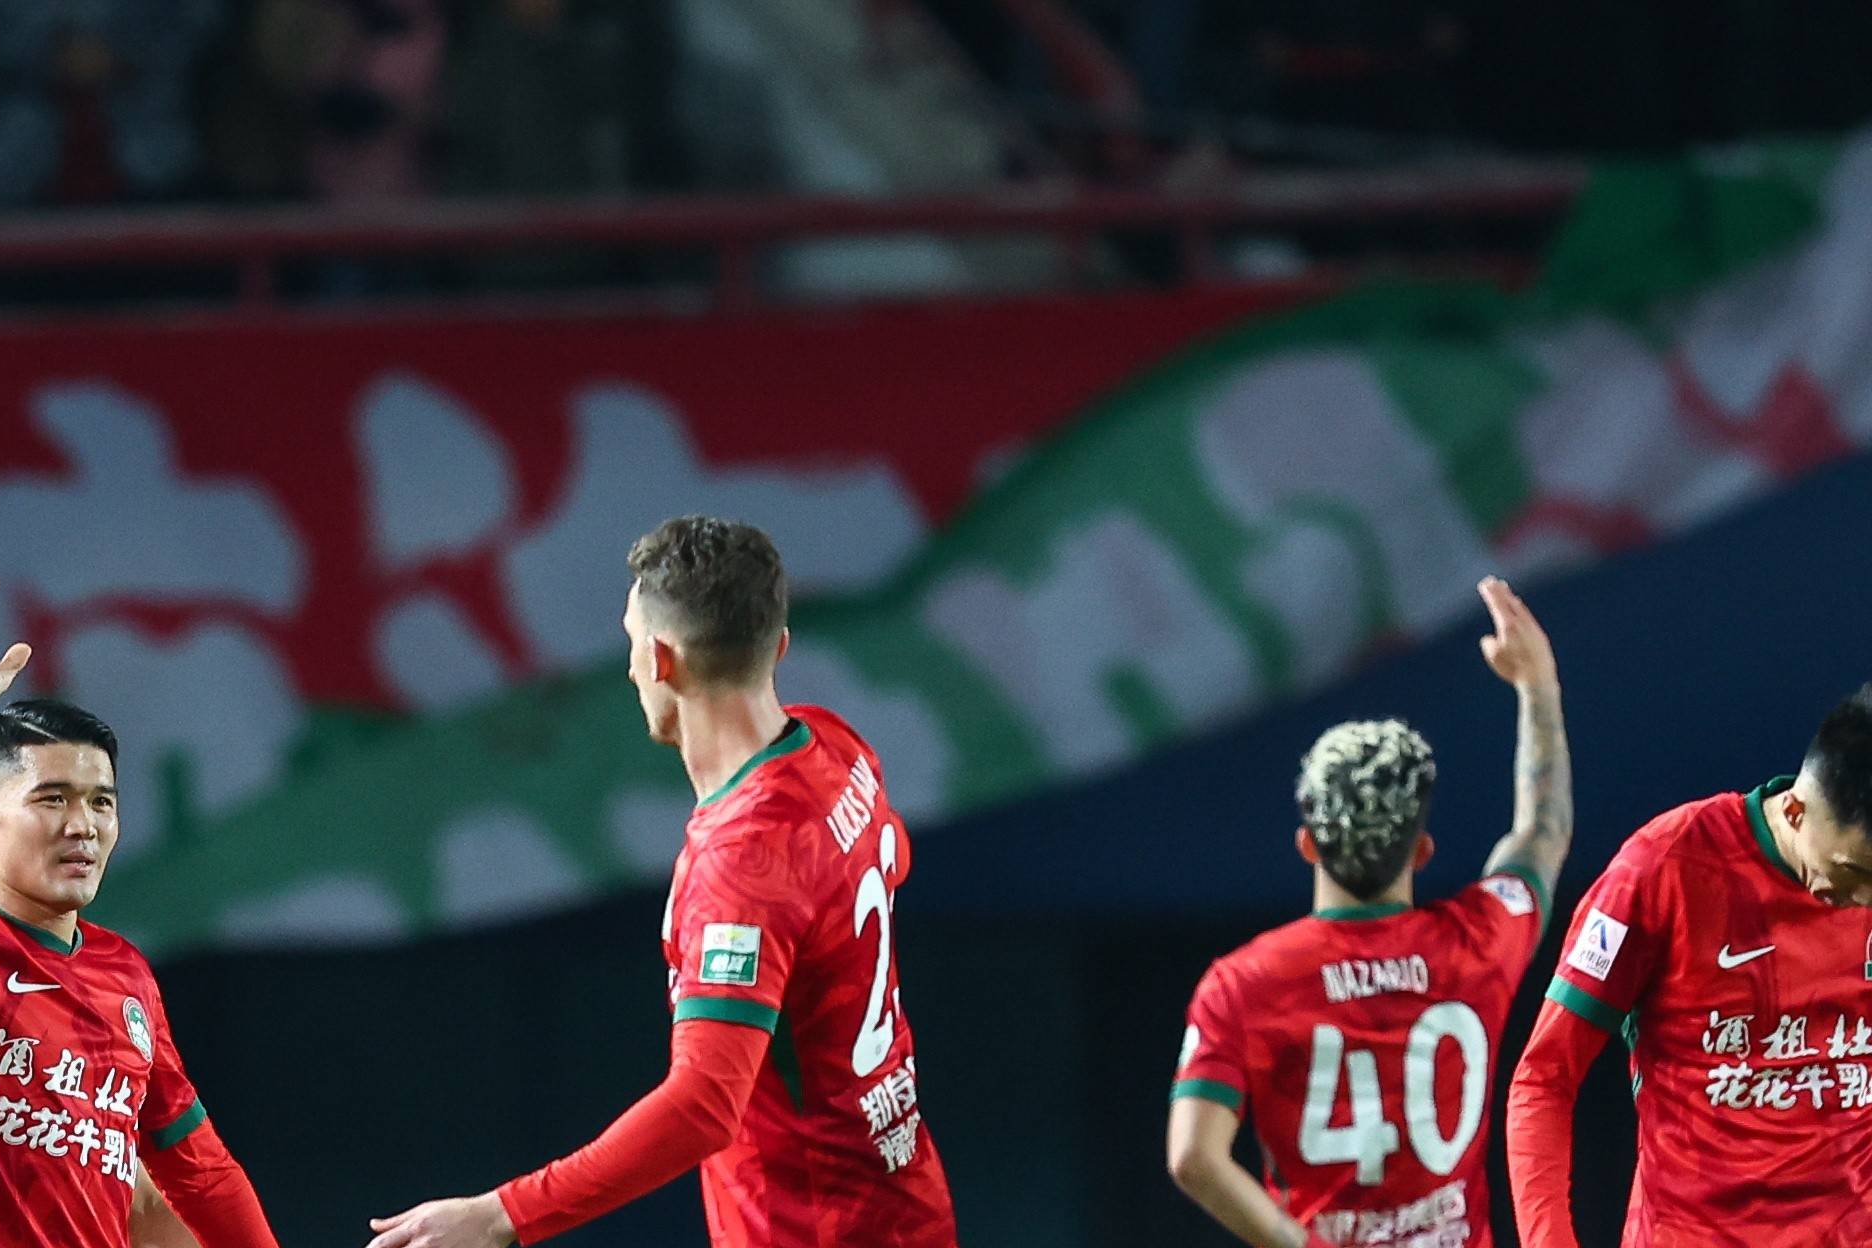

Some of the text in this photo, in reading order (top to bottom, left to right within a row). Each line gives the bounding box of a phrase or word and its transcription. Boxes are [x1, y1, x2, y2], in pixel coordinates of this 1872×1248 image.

[1299, 1000, 1489, 1187] 40
[1704, 1060, 1872, 1111] 花花牛乳
